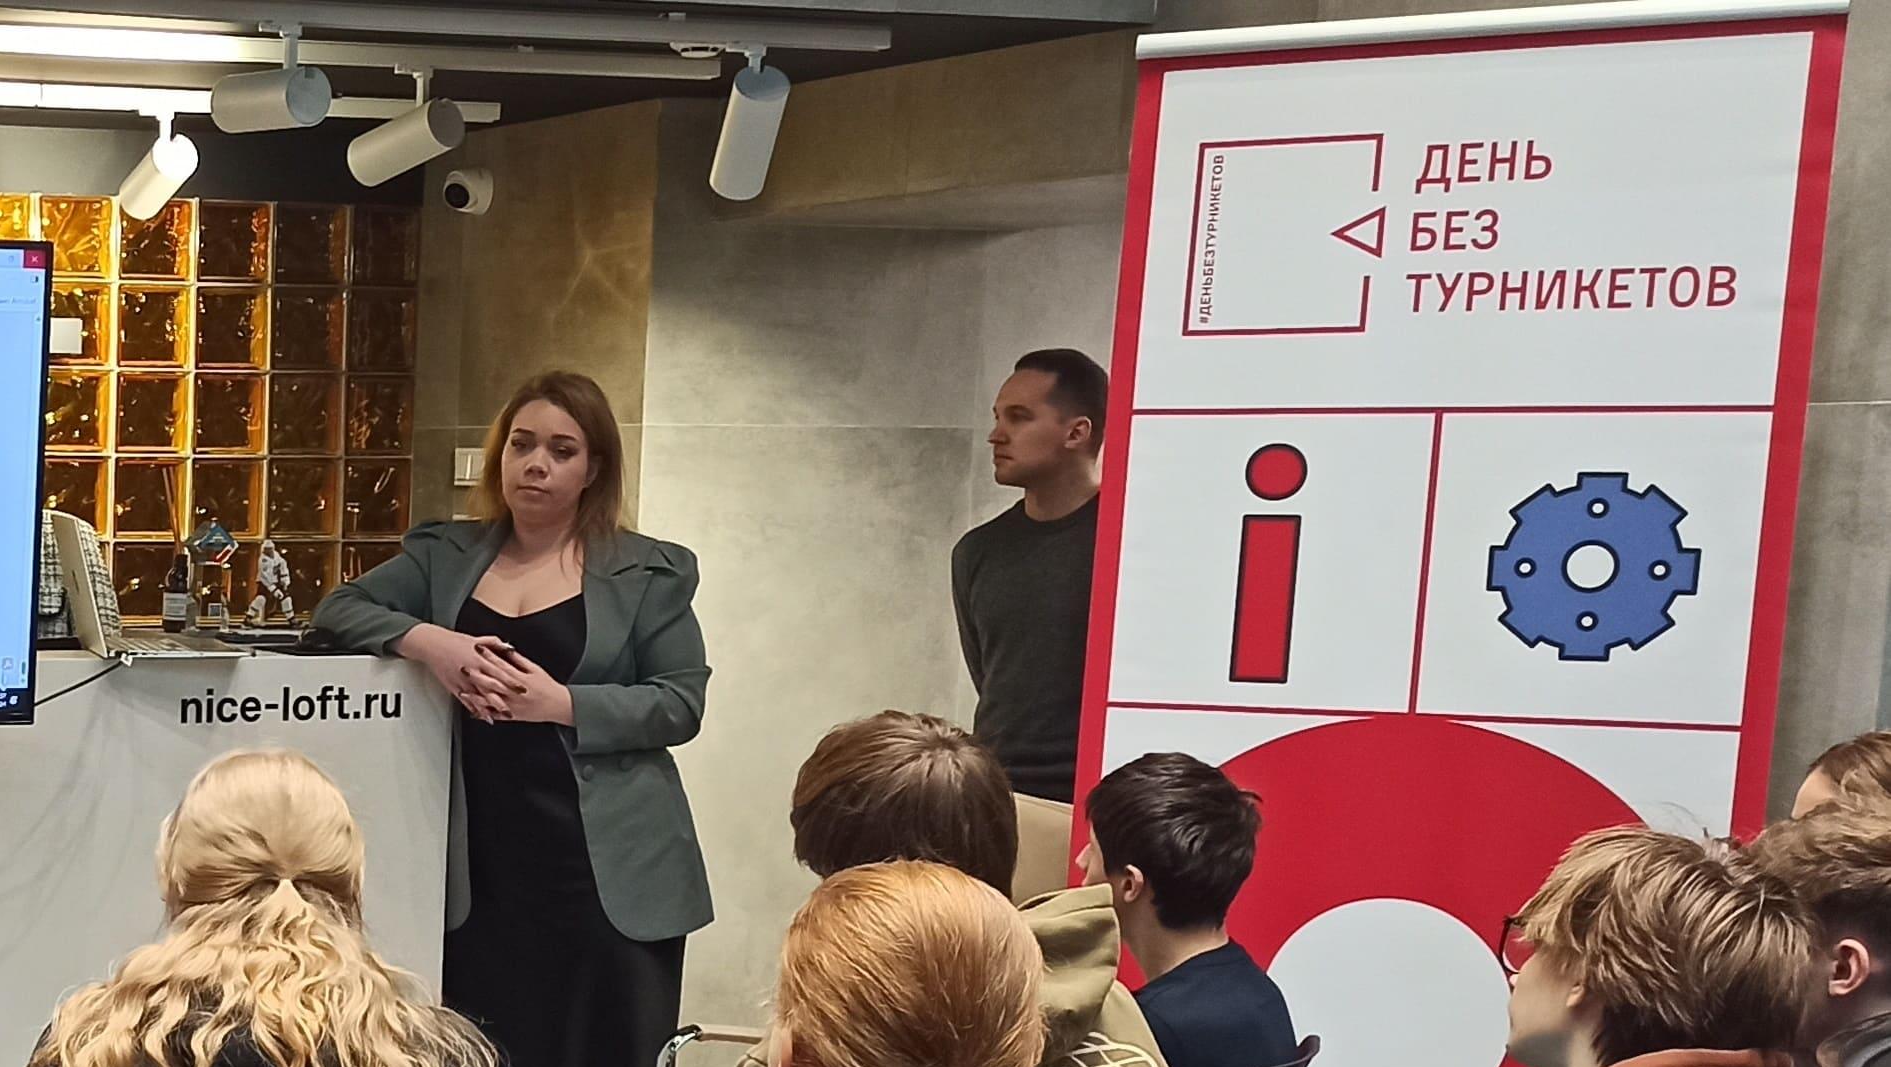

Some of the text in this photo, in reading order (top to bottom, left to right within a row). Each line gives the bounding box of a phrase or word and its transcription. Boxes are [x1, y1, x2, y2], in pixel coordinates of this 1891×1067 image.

[1414, 140, 1553, 194] ДЕНЬ
[1199, 154, 1225, 324] #ДЕНЬБЕЗТУРНИКЕТОВ
[1409, 208, 1500, 252] БЕЗ
[1405, 265, 1738, 313] ТУРНИКЕТОВ
[180, 685, 402, 724] nice-loft.ru
